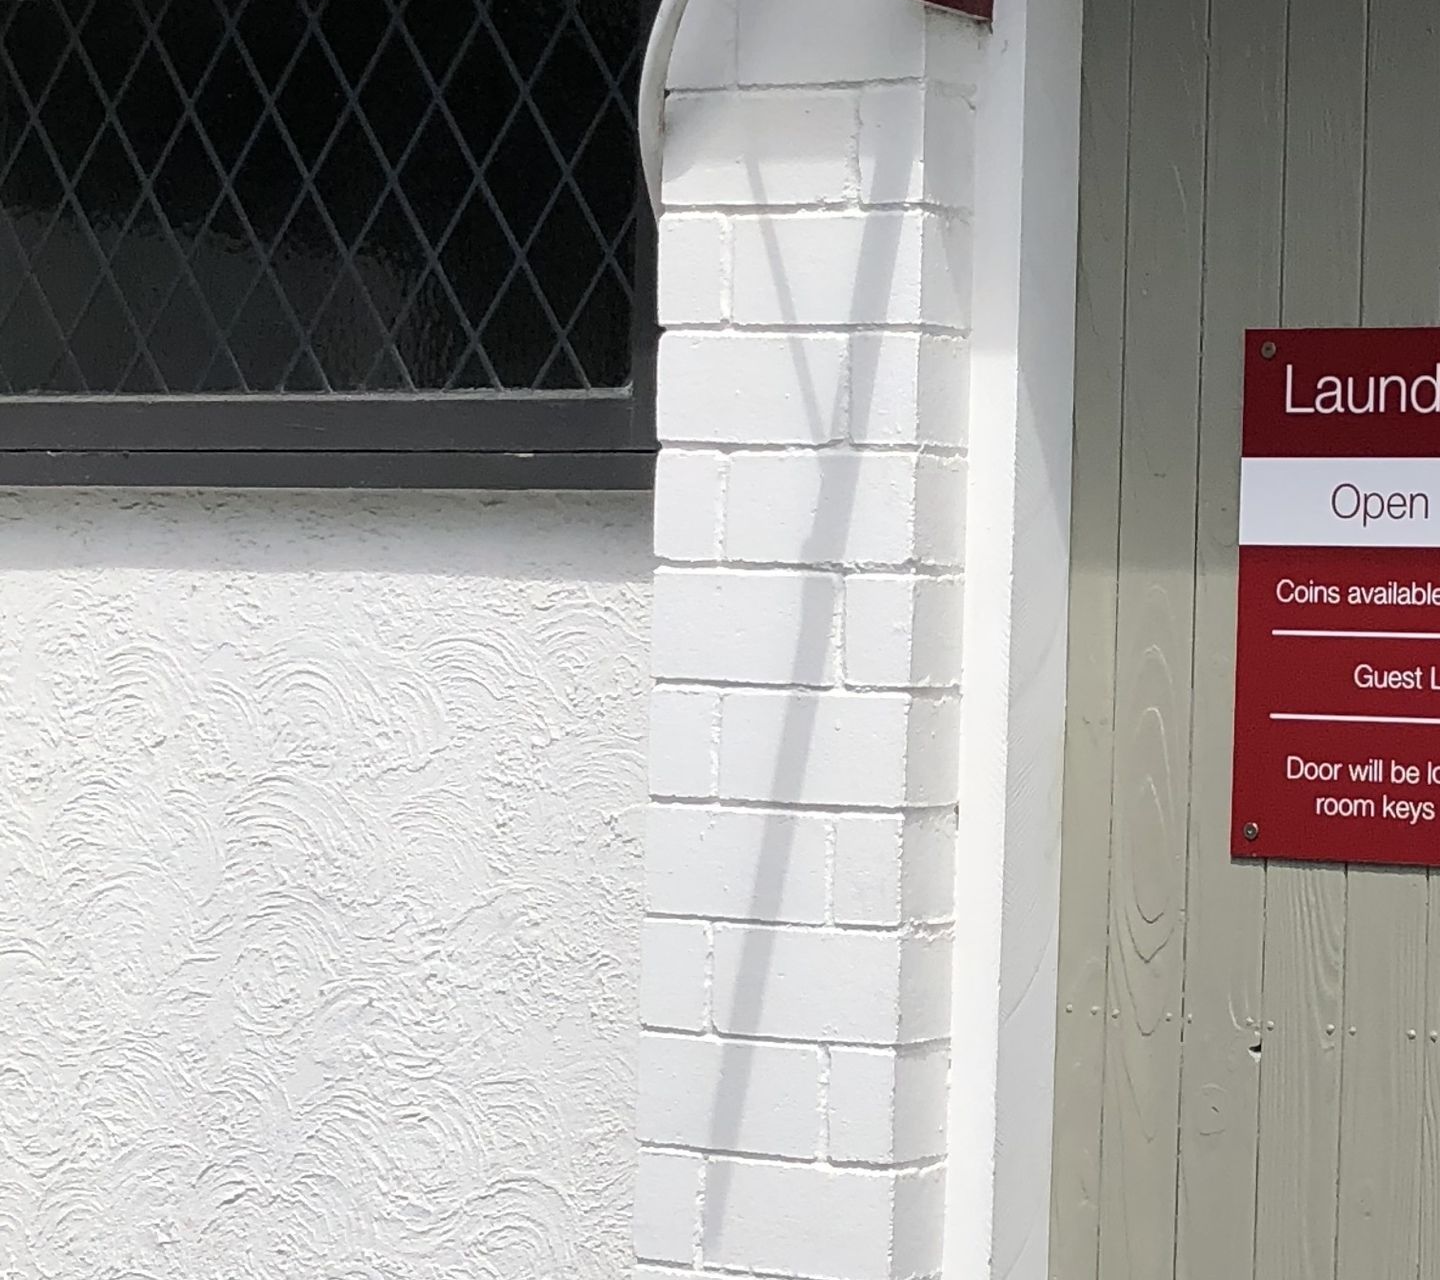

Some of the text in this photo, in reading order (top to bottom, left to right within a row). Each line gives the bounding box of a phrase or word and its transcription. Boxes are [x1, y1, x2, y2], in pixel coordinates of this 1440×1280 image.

[1332, 483, 1429, 527] Open
[1276, 578, 1341, 604] Coins
[1353, 663, 1423, 690] Guest
[1286, 755, 1343, 781] Door
[1348, 759, 1383, 783] will
[1390, 759, 1420, 785] be
[1316, 797, 1375, 817] room
[1382, 796, 1436, 826] keys
